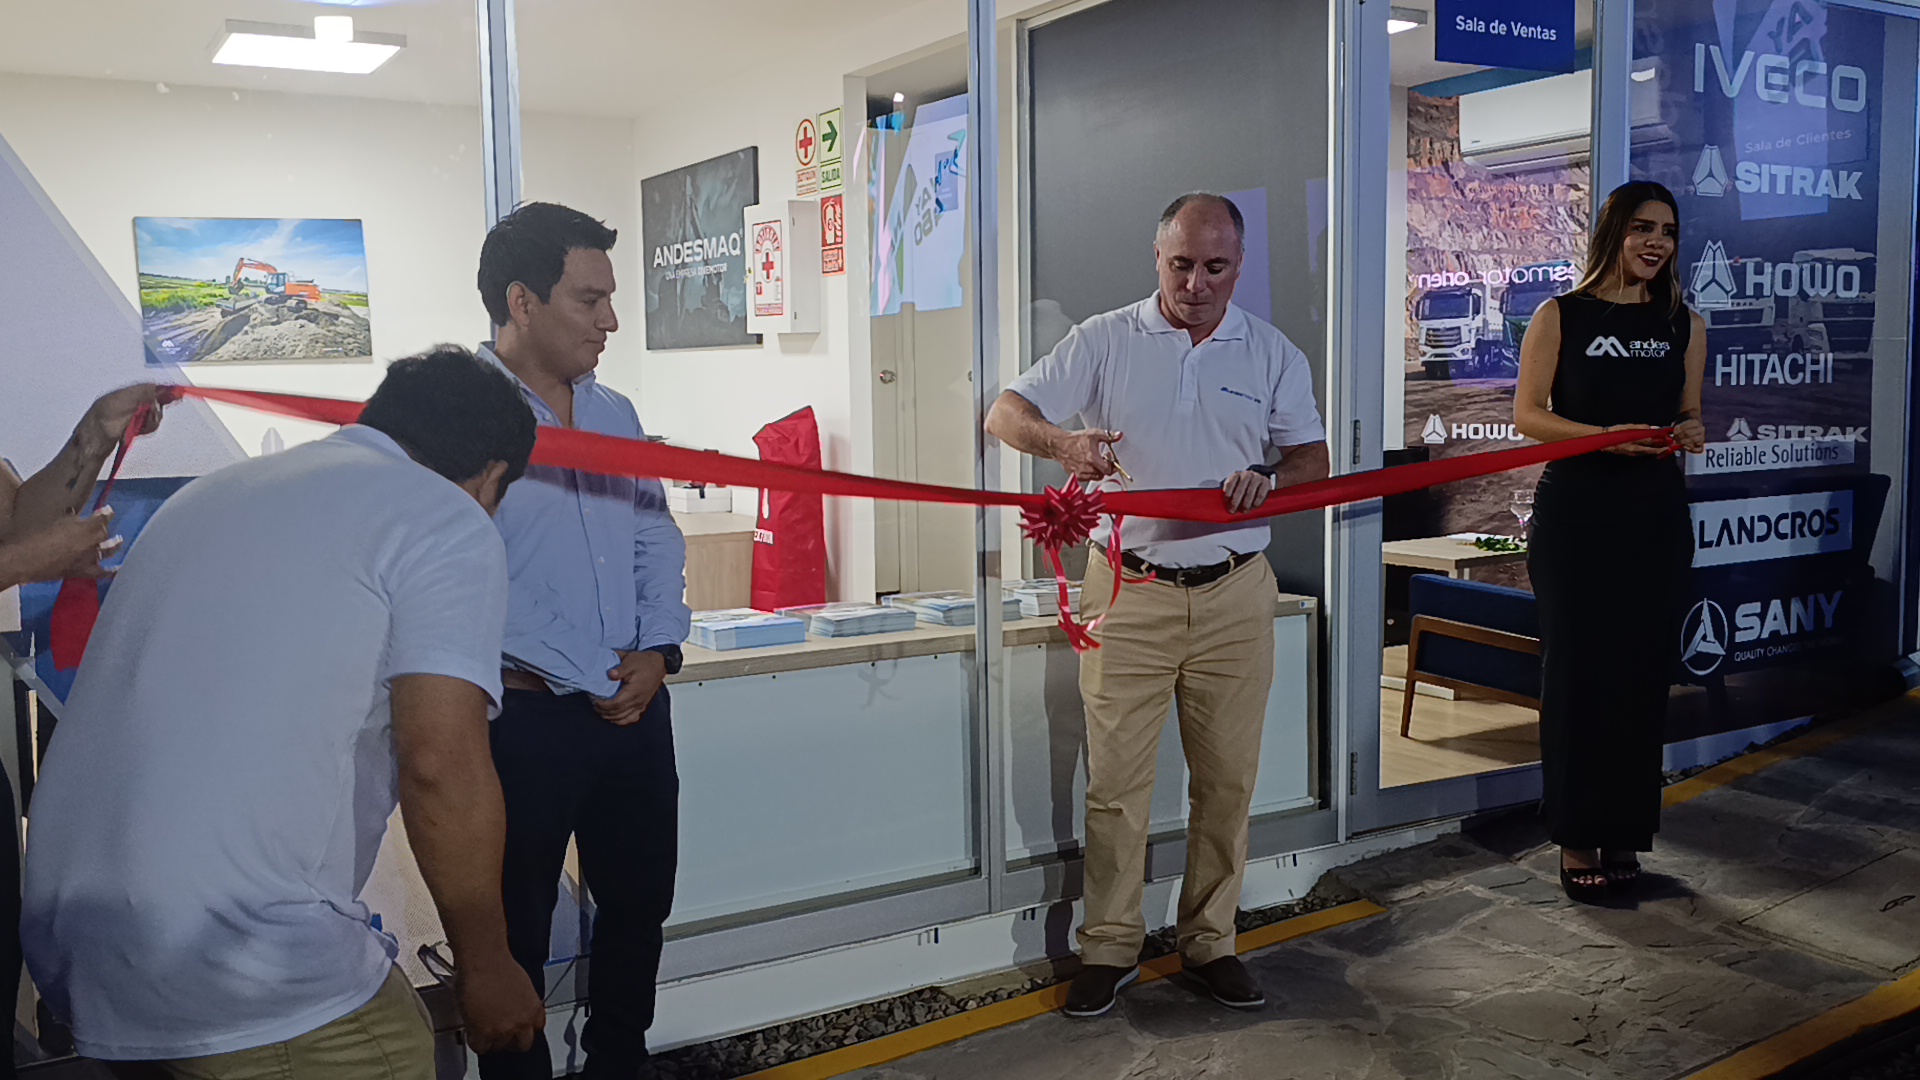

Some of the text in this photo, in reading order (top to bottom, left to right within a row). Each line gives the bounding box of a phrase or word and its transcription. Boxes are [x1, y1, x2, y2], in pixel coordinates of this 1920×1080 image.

[1455, 15, 1557, 40] Sala de Ventas
[1694, 42, 1867, 112] IVECO
[1744, 129, 1853, 153] Sala de Clientes
[821, 167, 841, 184] SALIDA
[1735, 161, 1863, 200] SITRAK
[653, 232, 741, 268] ANDESMAQ
[1746, 262, 1860, 298] HOWO
[1629, 338, 1670, 350] andes
[1630, 349, 1666, 357] motor
[1715, 353, 1833, 386] HITACHI
[1757, 425, 1868, 442] SITRAK
[1705, 442, 1839, 468] Reliable Solutions
[1699, 507, 1840, 549] LANDCROS
[1735, 590, 1843, 642] SANY
[1735, 648, 1764, 662] QUALITY
